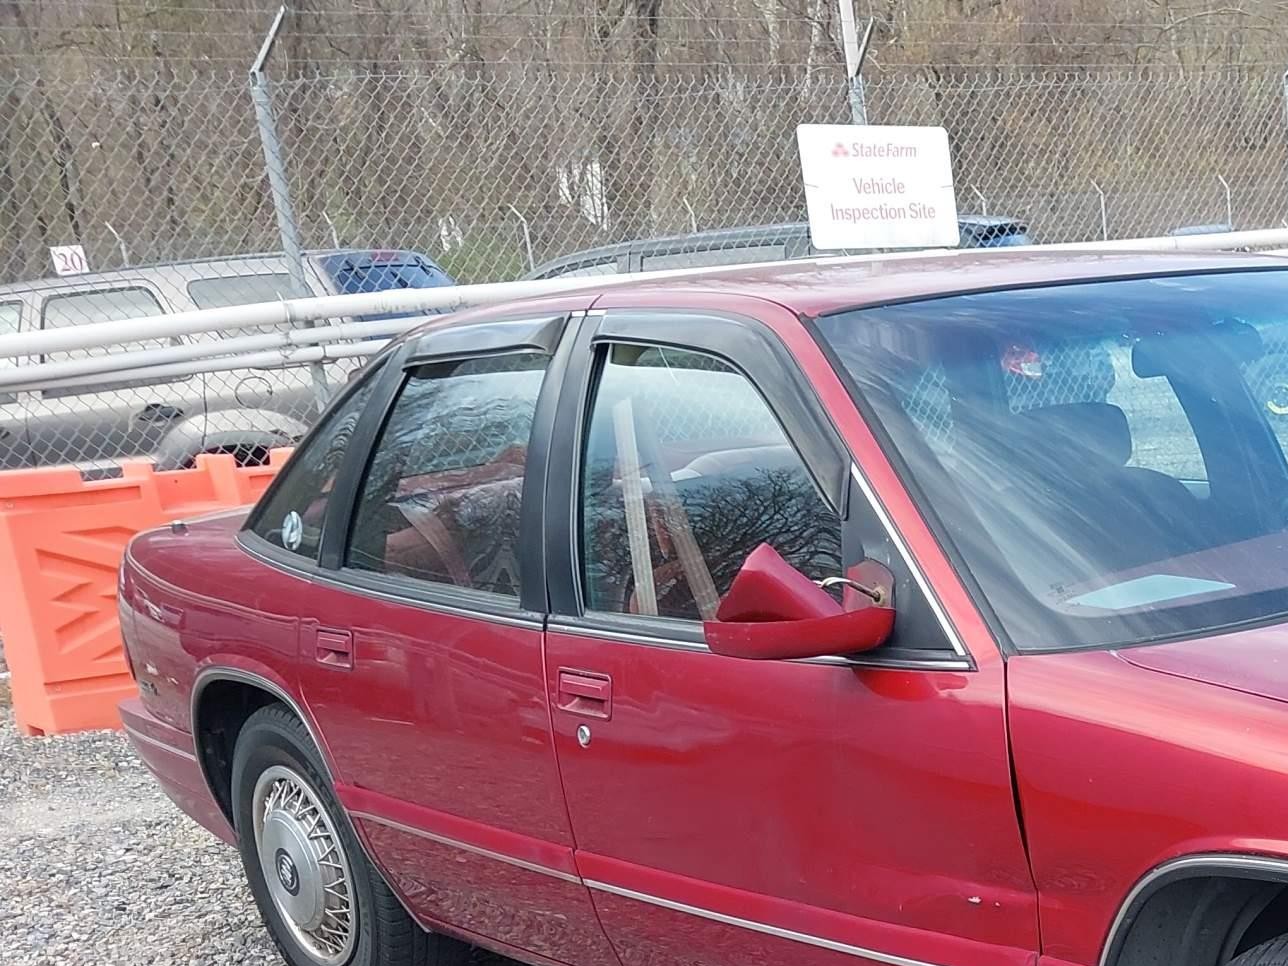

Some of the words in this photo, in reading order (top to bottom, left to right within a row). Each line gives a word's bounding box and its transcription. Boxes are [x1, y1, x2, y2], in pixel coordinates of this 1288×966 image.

[853, 178, 905, 194] Vehicle
[831, 203, 906, 223] Inspection
[908, 202, 936, 220] Site
[58, 252, 83, 272] 20
